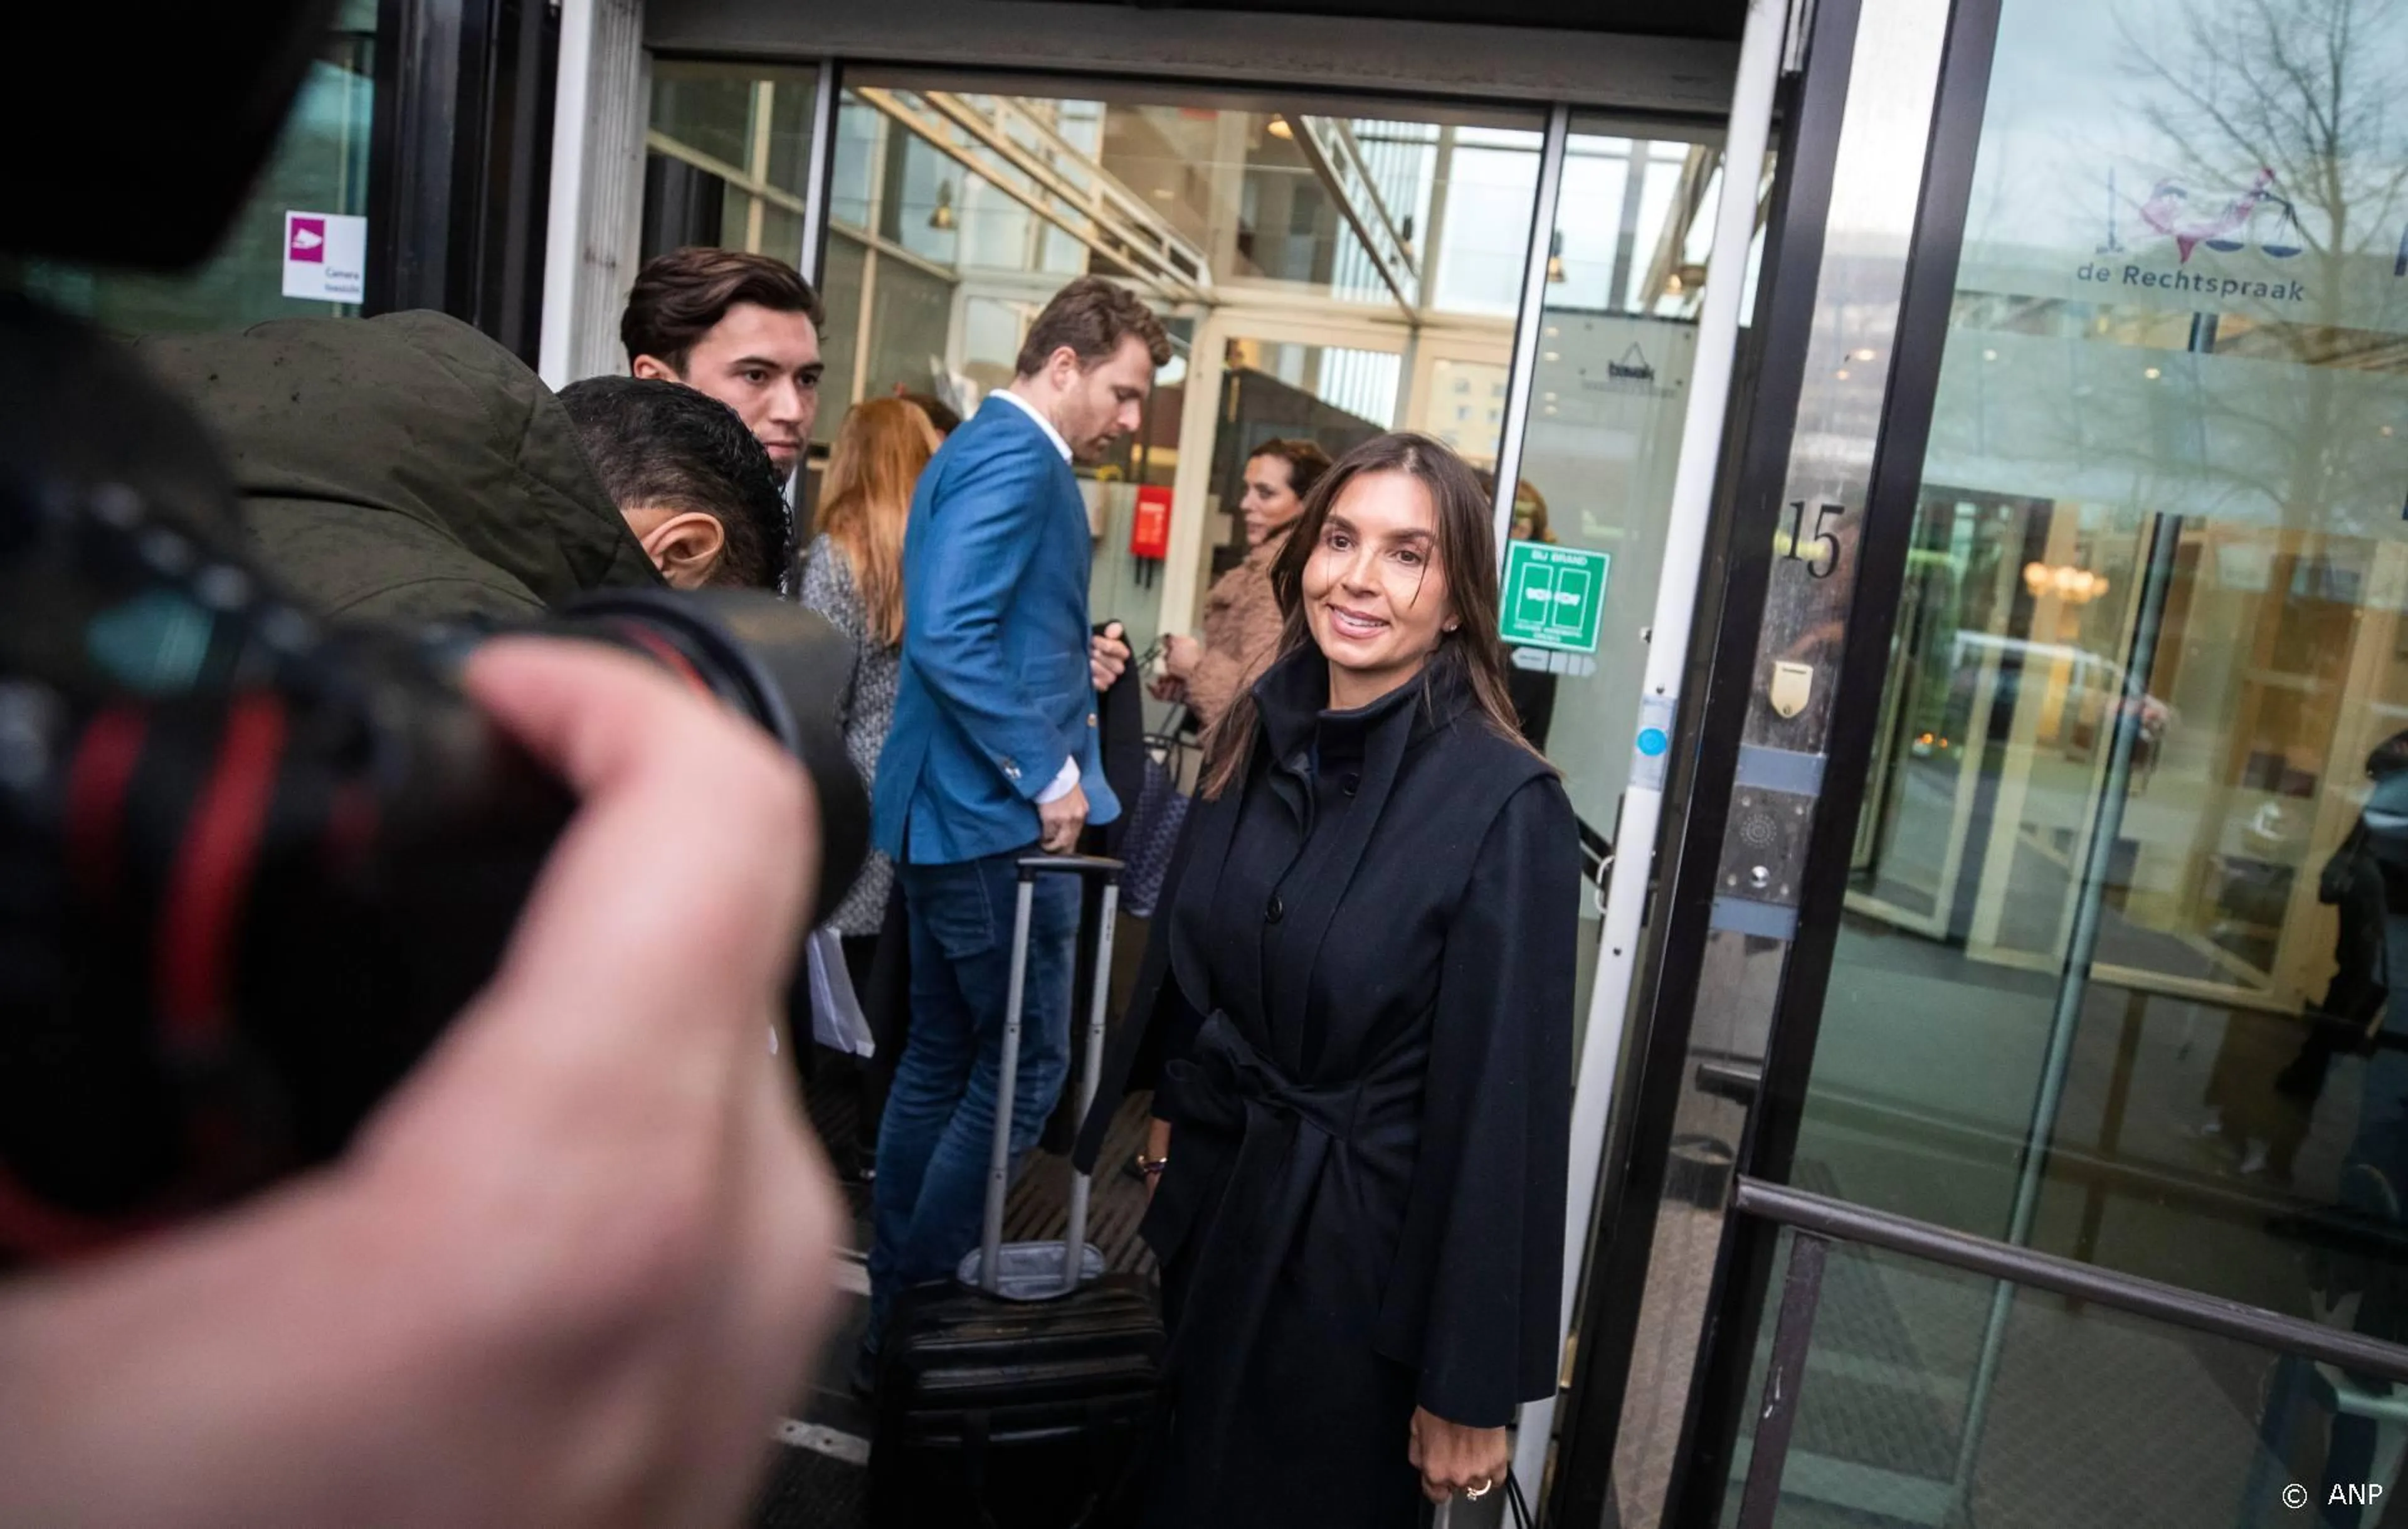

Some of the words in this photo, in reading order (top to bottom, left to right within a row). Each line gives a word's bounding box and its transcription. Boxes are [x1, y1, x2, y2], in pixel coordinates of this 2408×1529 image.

[2077, 262, 2110, 282] de
[2122, 264, 2305, 302] Rechtspraak
[1551, 552, 1588, 566] BRAND
[1782, 500, 1845, 579] 15
